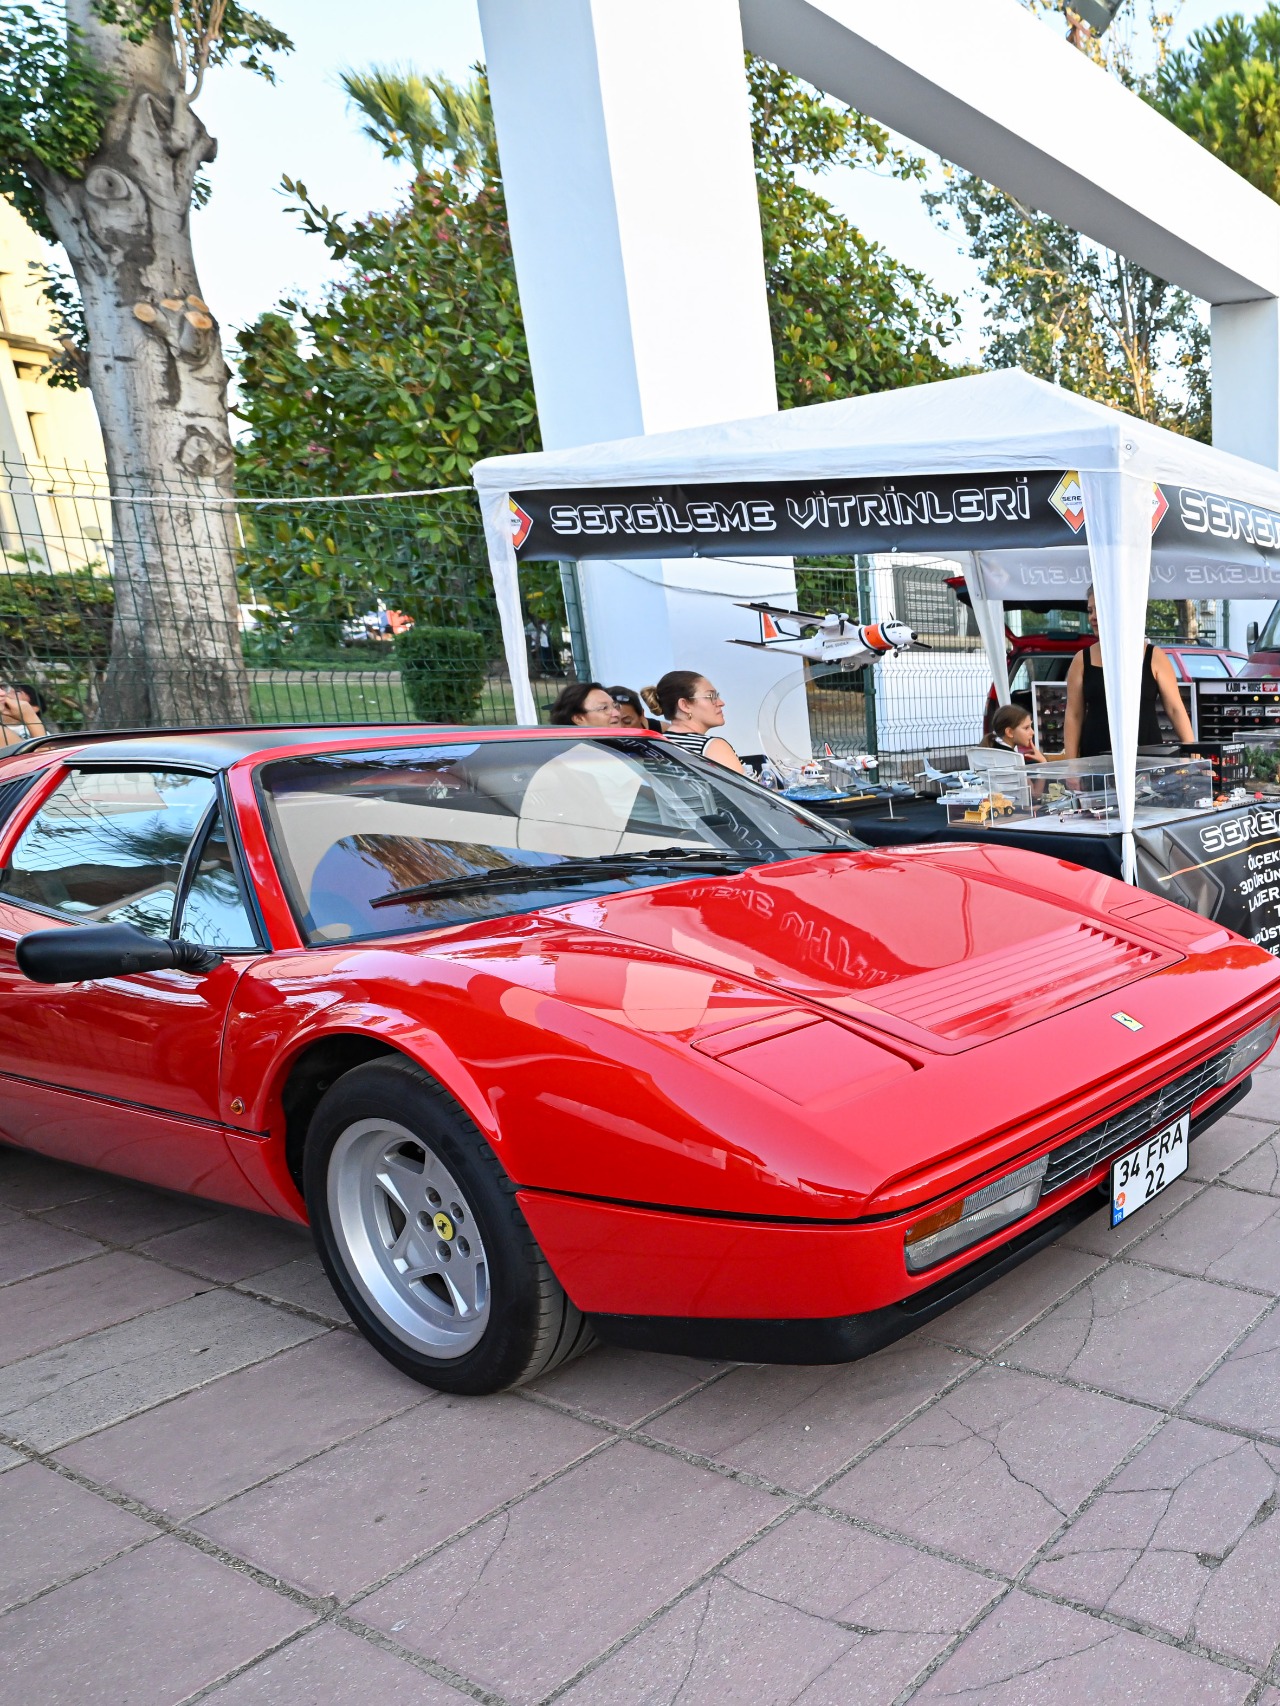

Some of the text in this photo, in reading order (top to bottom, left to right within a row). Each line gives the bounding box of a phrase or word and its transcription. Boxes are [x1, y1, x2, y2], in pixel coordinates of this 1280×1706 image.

[549, 475, 1031, 535] SERGİLEME VİTRİNLERİ
[1248, 886, 1280, 913] LAZER
[1119, 1122, 1184, 1188] 34 FRA
[1144, 1162, 1166, 1199] 22
[1114, 1211, 1124, 1223] TR
